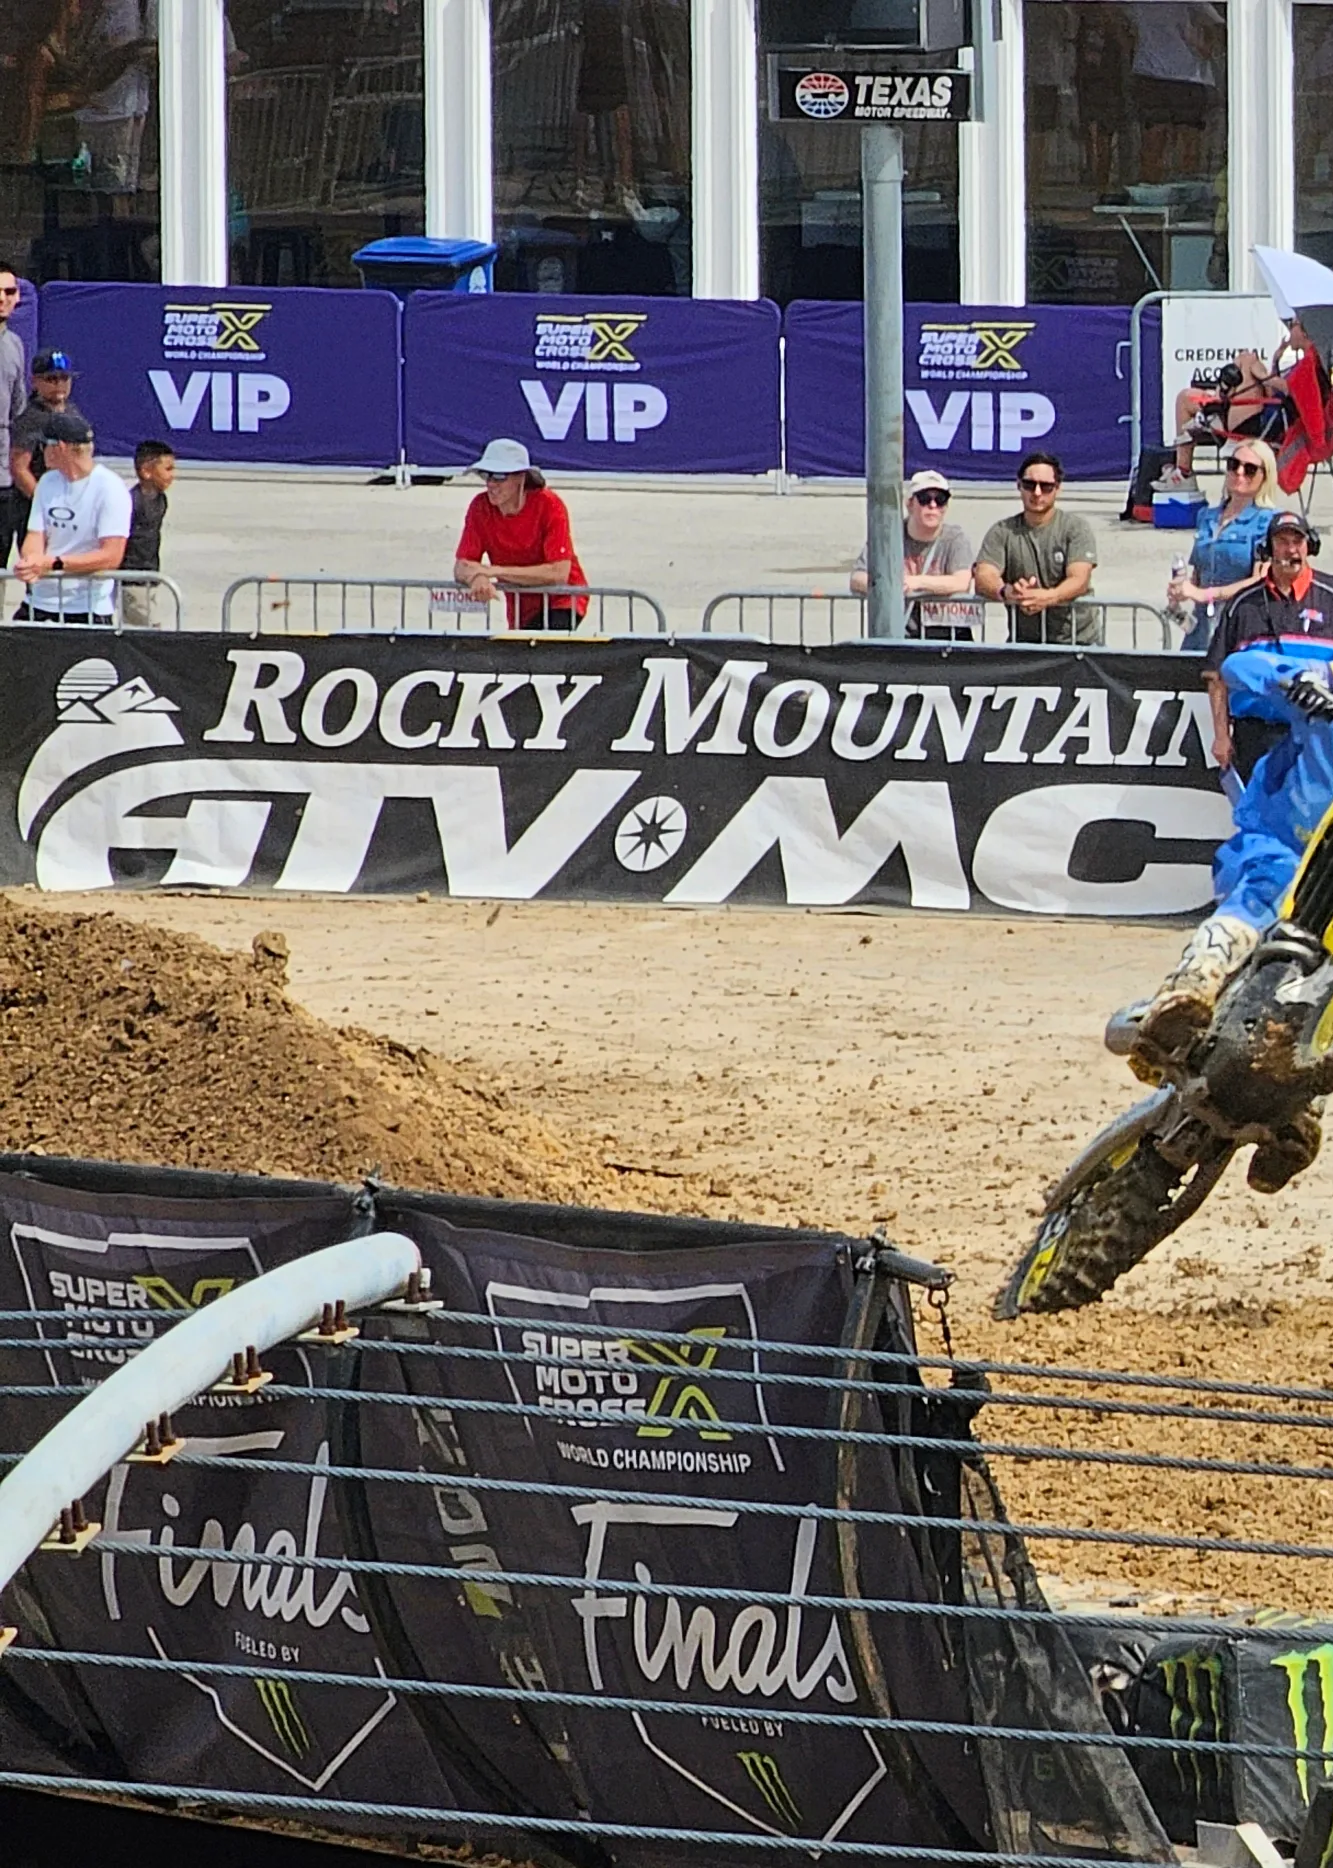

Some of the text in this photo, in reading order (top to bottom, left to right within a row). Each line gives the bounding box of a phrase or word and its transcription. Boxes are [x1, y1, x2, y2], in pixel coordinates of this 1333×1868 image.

[854, 75, 953, 107] TEXAS
[854, 106, 892, 117] MOTOR
[164, 313, 220, 325] SUPER
[167, 325, 218, 336] MOTO
[536, 323, 593, 335] SUPER
[539, 335, 591, 346] MOTO
[920, 331, 978, 344] SUPER
[923, 344, 977, 355] MOTO
[148, 369, 291, 433] VIP
[520, 379, 668, 442] VIP
[905, 389, 1056, 452] VIP
[431, 591, 486, 603] NATION
[923, 602, 980, 617] NATIONAL
[203, 649, 1224, 768] ROCKY MOUNTAIN
[35, 757, 642, 900] ATV
[662, 776, 1239, 917] MC
[48, 1270, 149, 1309] SUPER
[521, 1331, 630, 1364] SUPER
[536, 1365, 638, 1396] MOTO
[556, 1439, 752, 1475] WORLD CHAMPIONSHIP
[100, 1430, 371, 1634] Finals
[570, 1499, 858, 1703] Finals
[233, 1630, 301, 1664] FUELED BY
[701, 1714, 785, 1739] FUELED BY
